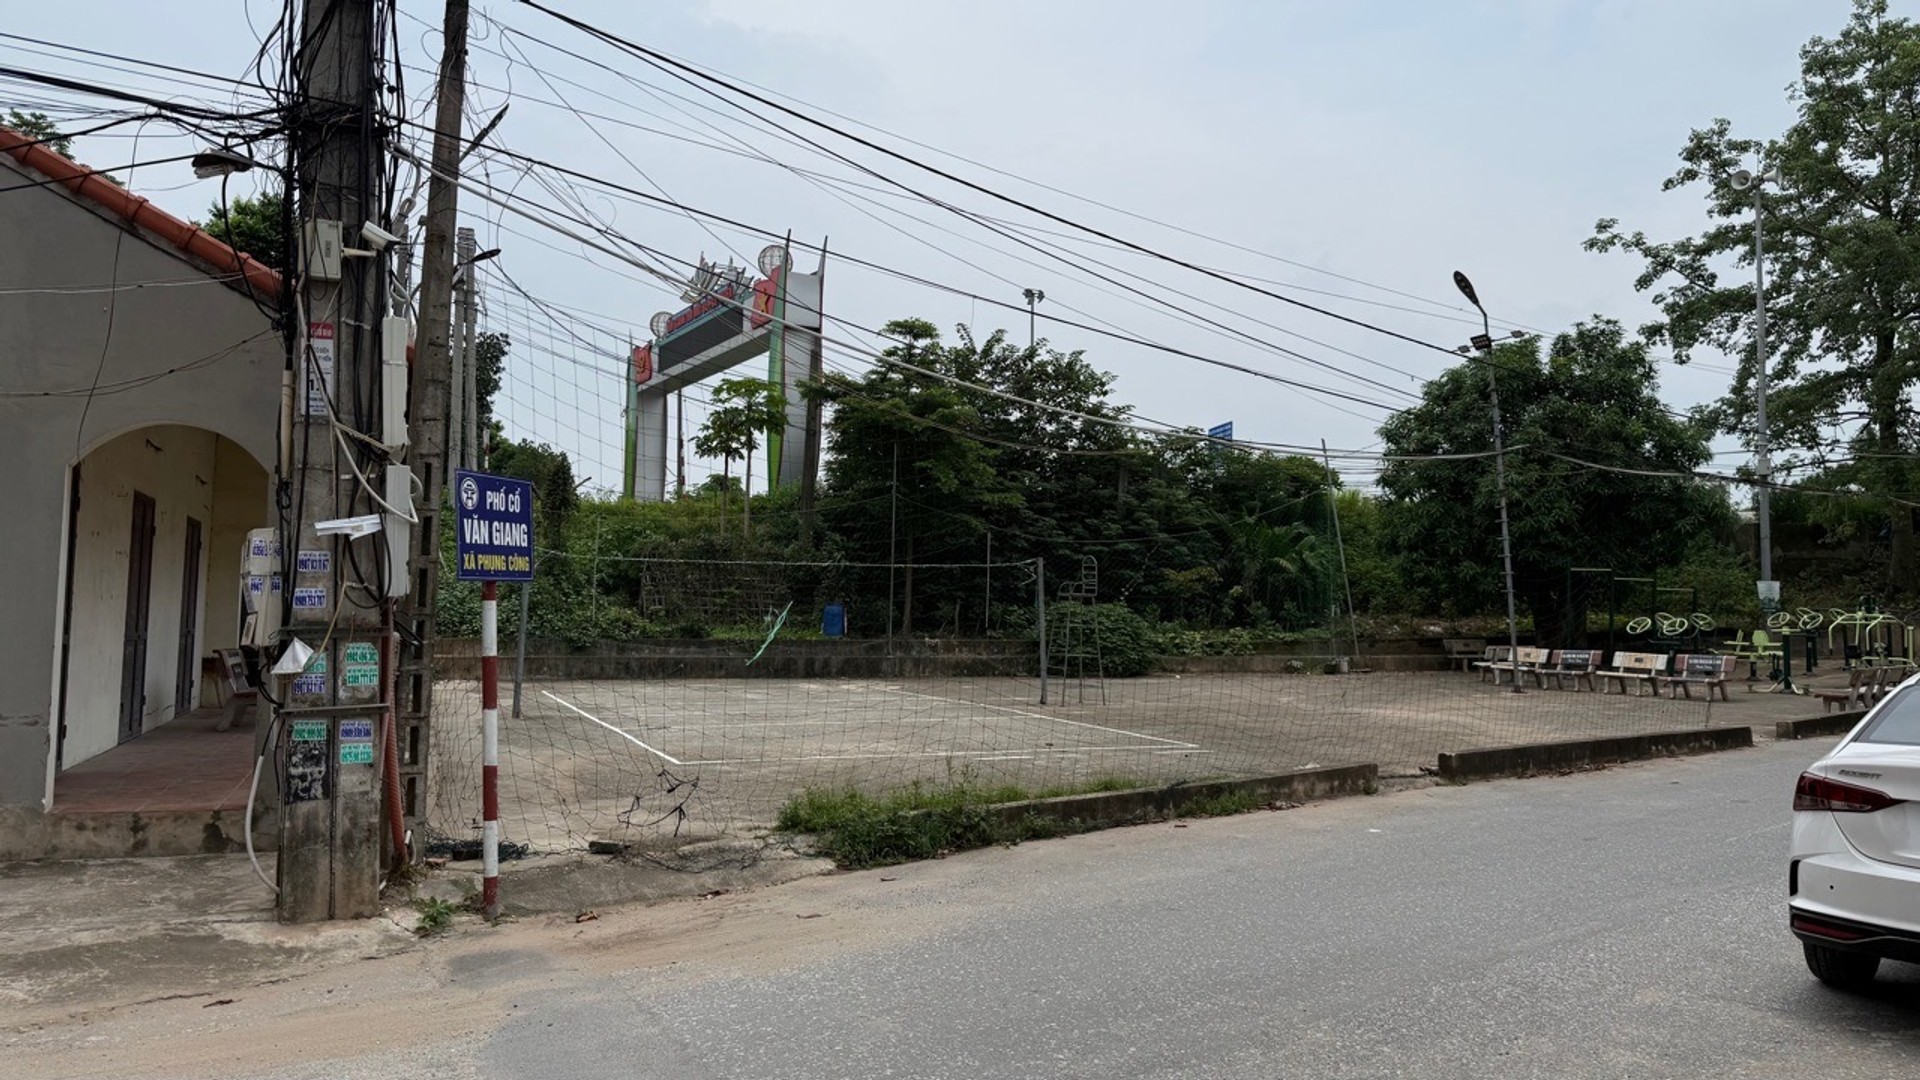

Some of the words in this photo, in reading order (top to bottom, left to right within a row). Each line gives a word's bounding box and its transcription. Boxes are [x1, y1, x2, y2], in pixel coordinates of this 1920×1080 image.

[485, 486, 506, 512] PHỐ
[508, 487, 521, 513] CỔ
[463, 514, 489, 545] VĂN
[492, 521, 528, 547] GIANG
[463, 551, 476, 569] XÃ
[478, 554, 506, 574] PHỤNG
[508, 553, 530, 572] CÔNG
